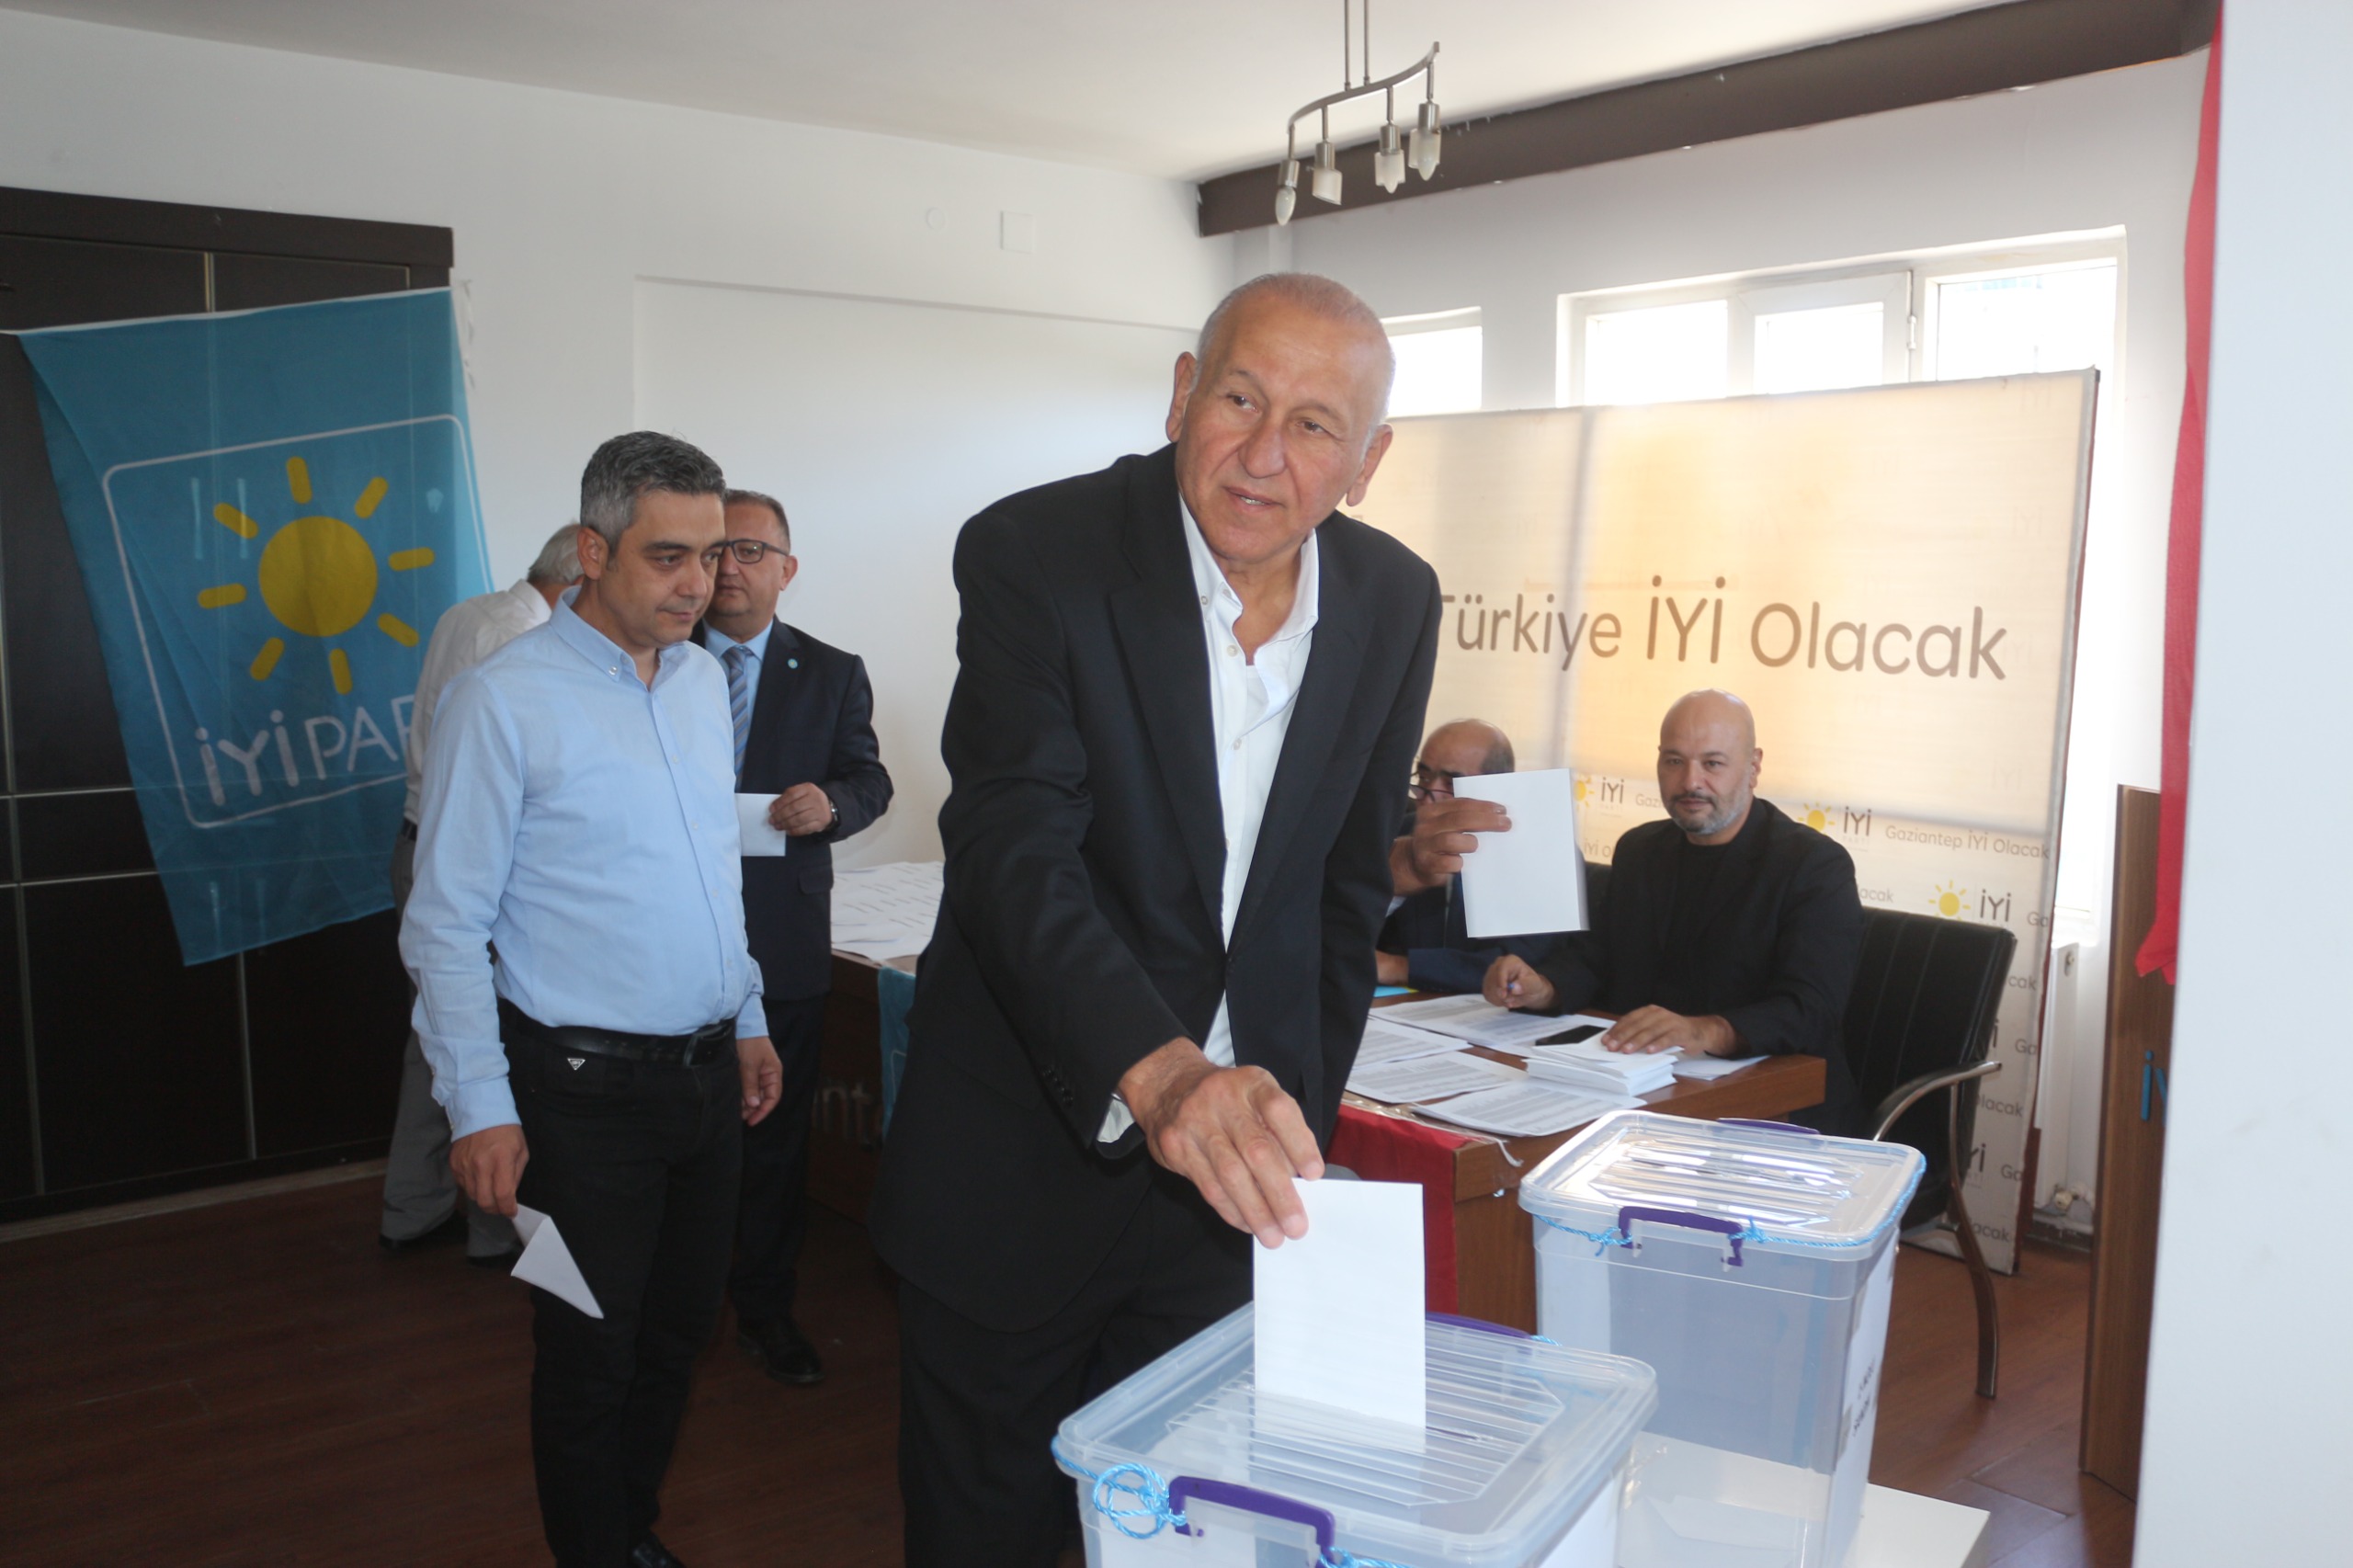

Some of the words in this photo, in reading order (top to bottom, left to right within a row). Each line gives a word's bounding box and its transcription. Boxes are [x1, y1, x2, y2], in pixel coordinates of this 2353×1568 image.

[1442, 593, 1621, 672] ürkiye
[1646, 574, 1726, 664] İYİ
[1750, 601, 2007, 681] Olacak
[195, 709, 301, 807] İYİ
[1600, 777, 1625, 804] İYİ
[1843, 805, 1871, 837] İYİ
[1885, 824, 1962, 851] Gaziantep
[1968, 829, 1988, 851] İYİ
[1993, 838, 2050, 859] Olacak
[1859, 886, 1894, 903] acak
[1980, 889, 2011, 922] İYİ
[2007, 975, 2038, 991] cak
[1978, 1093, 2024, 1118] lacak
[1975, 1223, 2010, 1243] acak
